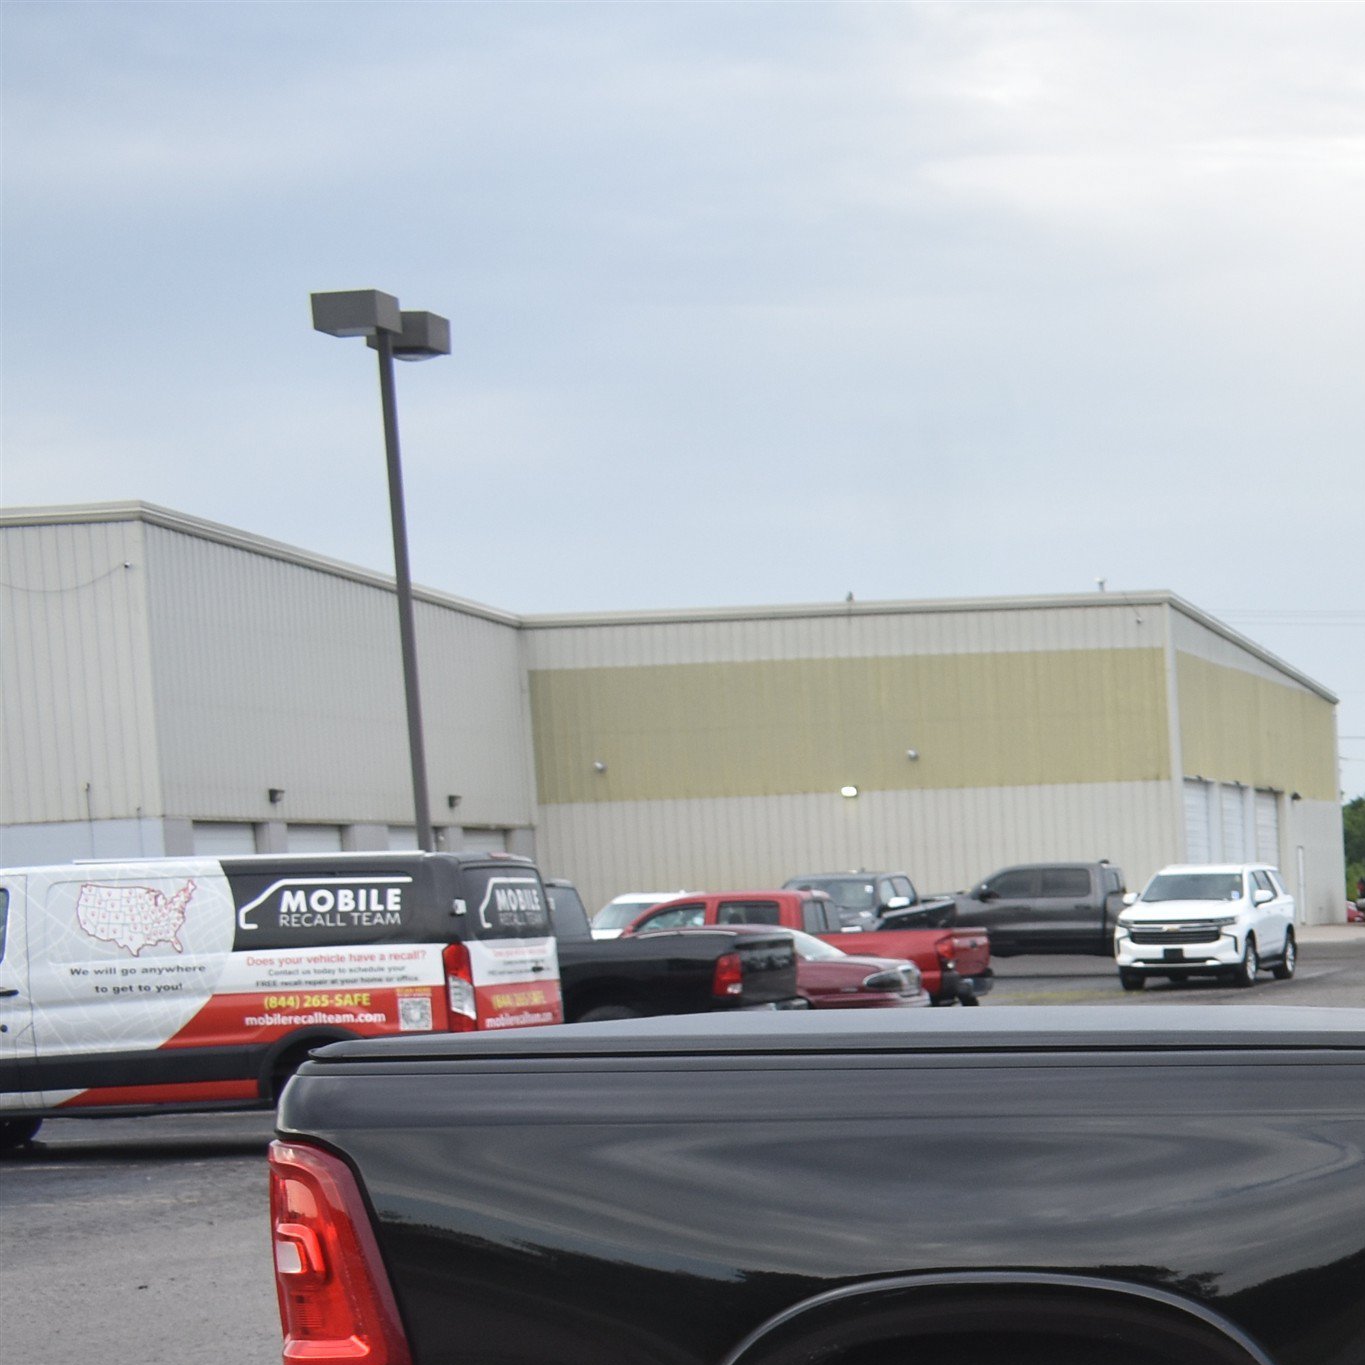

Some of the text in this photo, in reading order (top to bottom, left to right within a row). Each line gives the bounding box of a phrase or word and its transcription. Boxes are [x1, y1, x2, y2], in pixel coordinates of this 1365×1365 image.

[280, 889, 401, 912] MOBILE
[279, 913, 401, 927] RECALL TEAM
[246, 949, 427, 967] Does your vehicle have a recall?
[70, 965, 207, 977] We will go anywhere
[94, 983, 182, 995] to get to you!
[264, 993, 370, 1010] (844) 265-SAFE
[245, 1012, 386, 1026] mobilerecallteam.com
